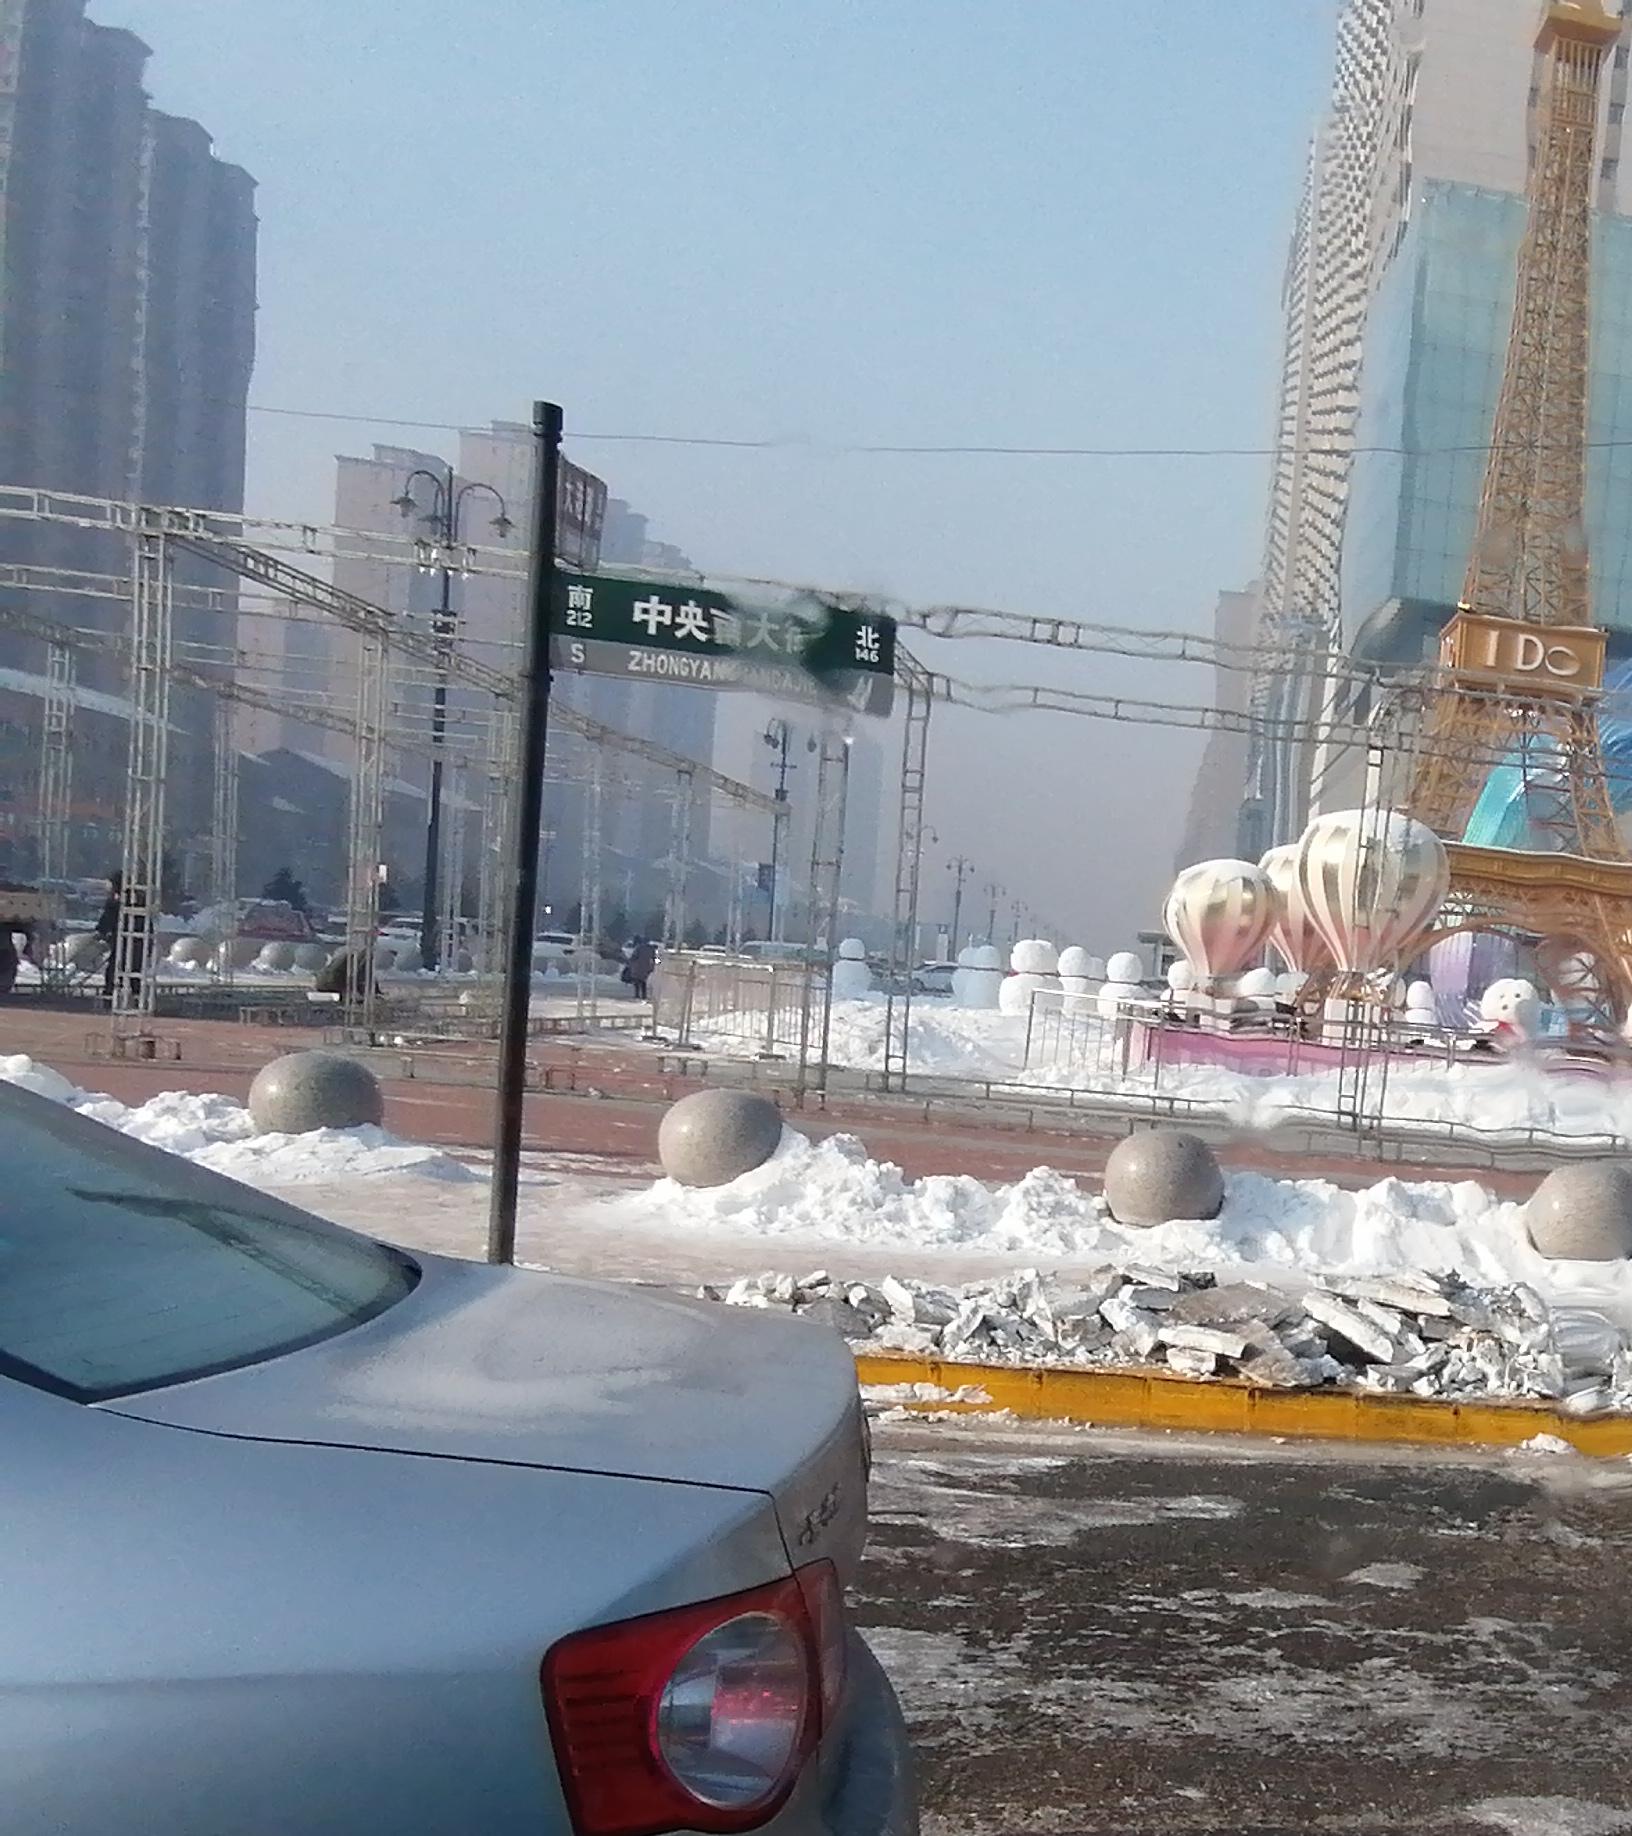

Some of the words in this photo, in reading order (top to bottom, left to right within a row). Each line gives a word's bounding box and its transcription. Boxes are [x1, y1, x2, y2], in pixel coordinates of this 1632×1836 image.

[567, 584, 593, 610] 南
[566, 609, 593, 628] 212
[856, 625, 880, 649] 北
[570, 643, 585, 663] S
[855, 648, 879, 663] 146
